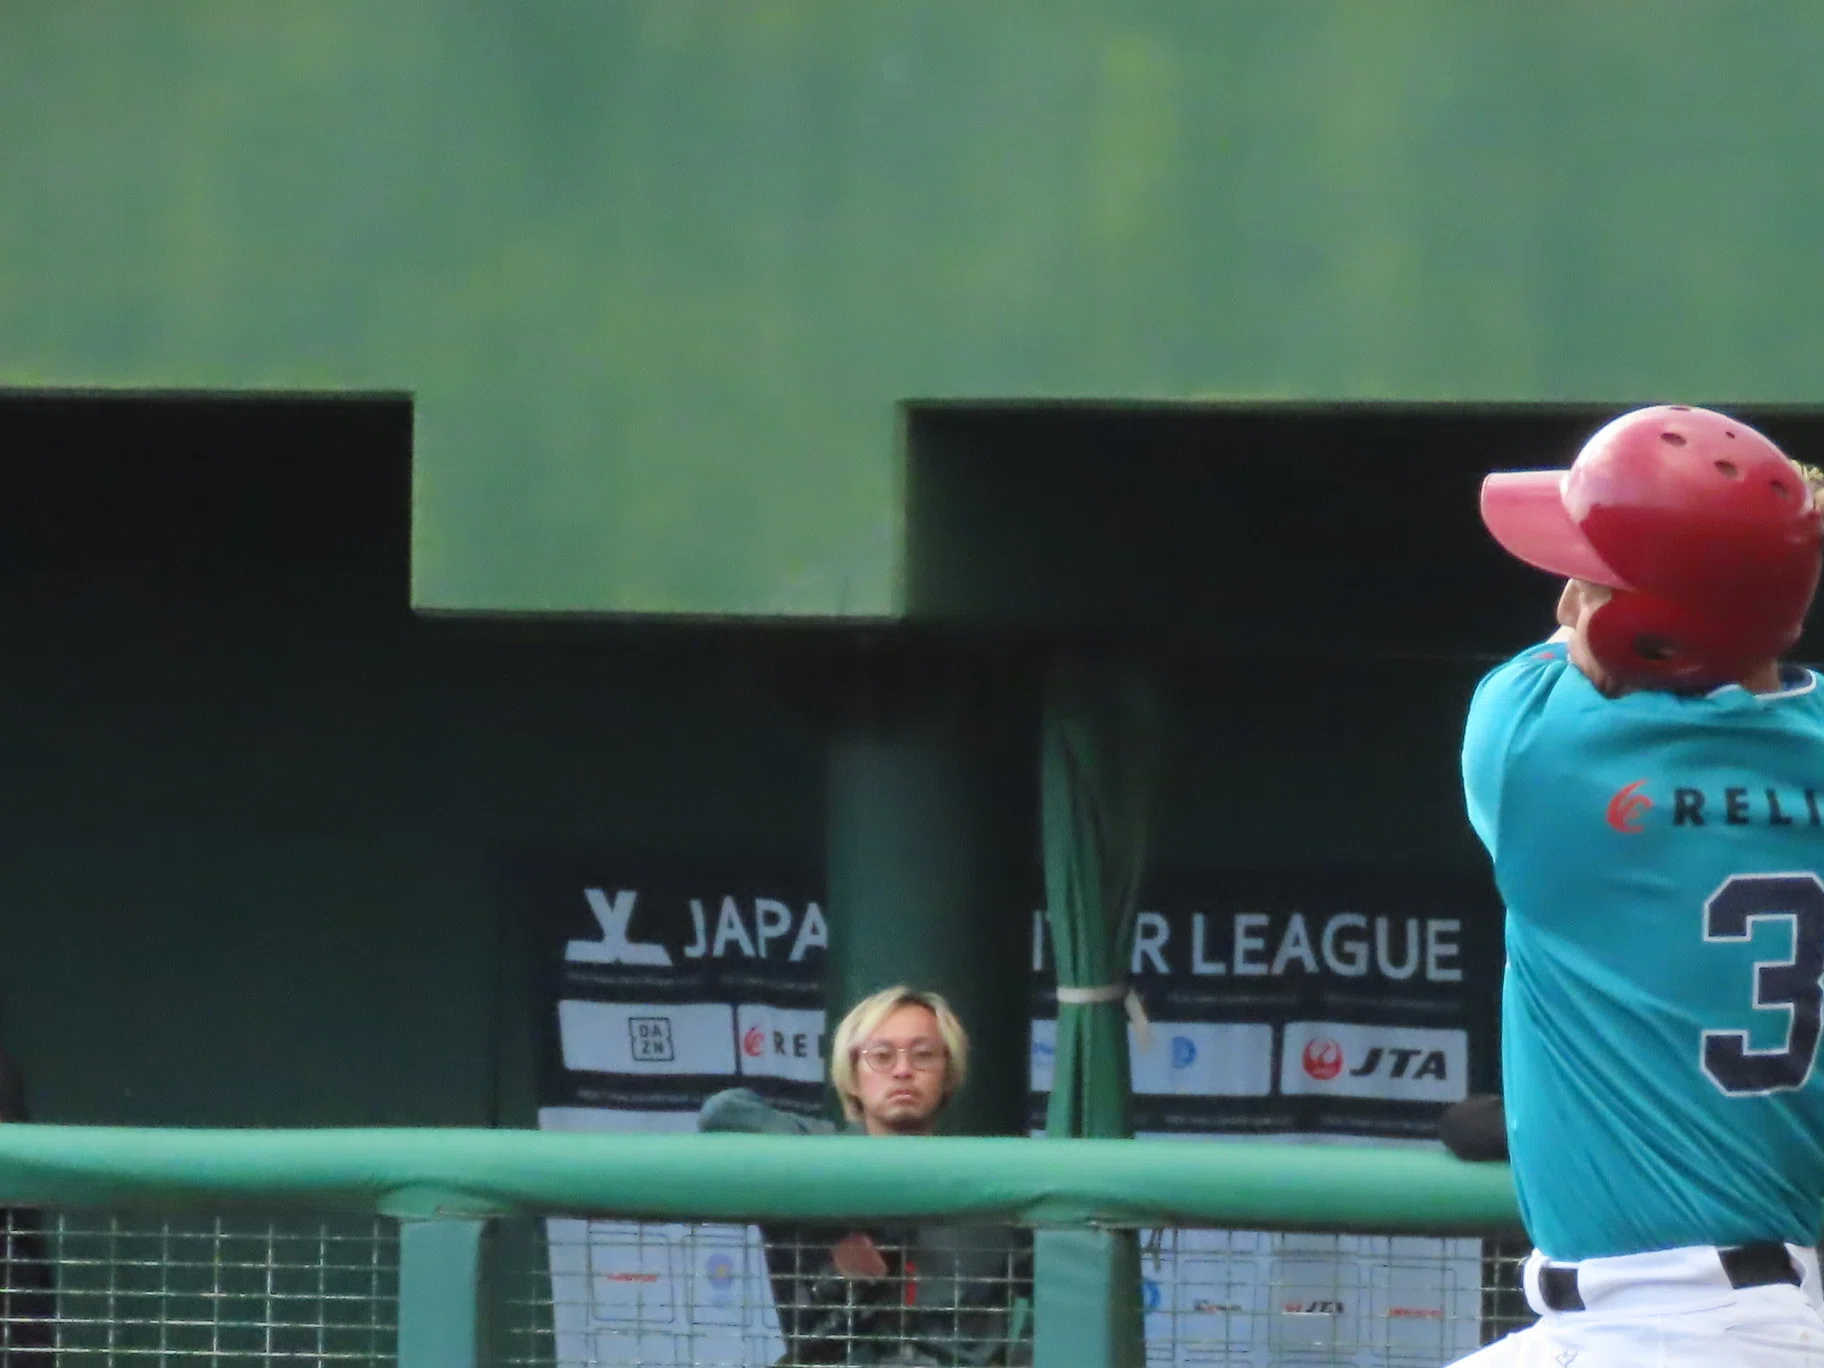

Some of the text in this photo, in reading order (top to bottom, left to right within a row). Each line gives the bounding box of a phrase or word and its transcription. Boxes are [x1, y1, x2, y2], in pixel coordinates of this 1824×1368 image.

[684, 895, 828, 962] JAPA
[1191, 911, 1463, 982] LEAGUE
[1349, 1047, 1448, 1081] JTA
